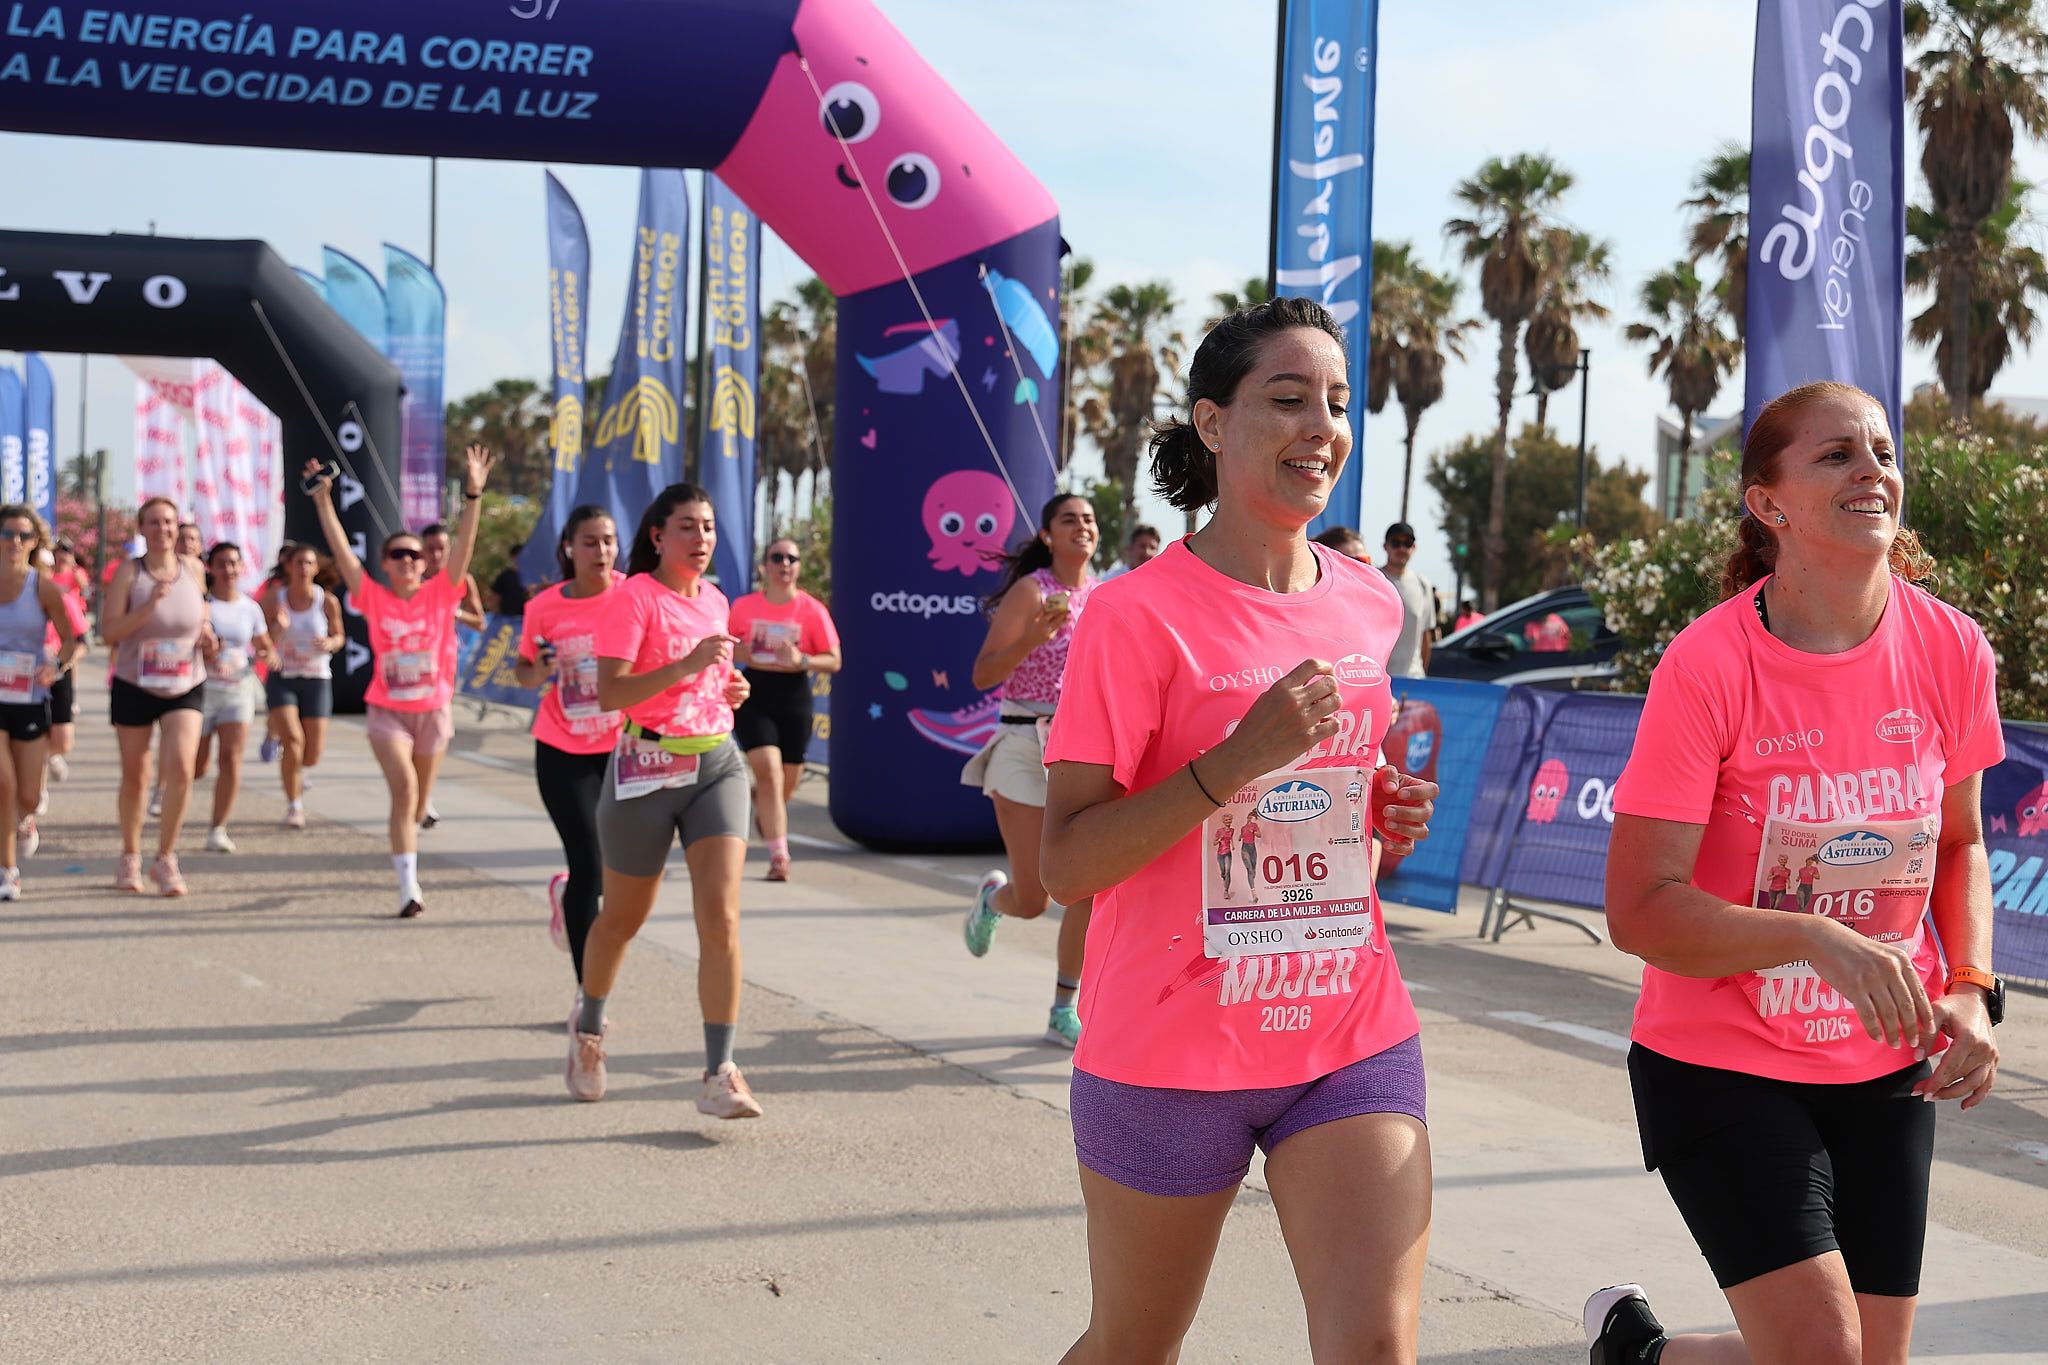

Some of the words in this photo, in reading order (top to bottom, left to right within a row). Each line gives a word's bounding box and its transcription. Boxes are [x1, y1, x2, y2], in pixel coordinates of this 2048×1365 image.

[6, 3, 66, 40] LA
[79, 9, 276, 57] ENERGÍA
[288, 26, 407, 66] PARA
[419, 35, 594, 78] CORRER
[0, 52, 31, 82] A
[45, 55, 102, 88] LA
[119, 61, 373, 106] VELOCIDAD
[381, 80, 443, 111] DE
[449, 85, 502, 115] LA
[514, 89, 599, 120] LUZ
[871, 590, 976, 620] octopus
[1209, 666, 1284, 692] OYSHO
[1755, 729, 1824, 756] OYSHO
[1262, 797, 1326, 814] ASTURIANA
[1781, 836, 1818, 848] SUMA
[1792, 830, 1819, 839] DORSAL
[1824, 845, 1887, 859] ASTURIANA
[1263, 852, 1329, 884] 016
[1281, 888, 1313, 902] 3926
[1989, 849, 2048, 916] PA
[1224, 910, 1265, 921] CARRERA
[1268, 908, 1278, 918] DE
[1280, 907, 1291, 917] LA
[1293, 905, 1322, 916] MUJER
[1329, 901, 1364, 914] VALENCIA
[1813, 889, 1875, 916] 016
[1228, 929, 1283, 945] OYSHO
[1318, 926, 1365, 939] Santander
[1217, 950, 1356, 1006] MUJER
[1260, 1005, 1312, 1032] 2026
[1804, 1016, 1850, 1043] 2026
